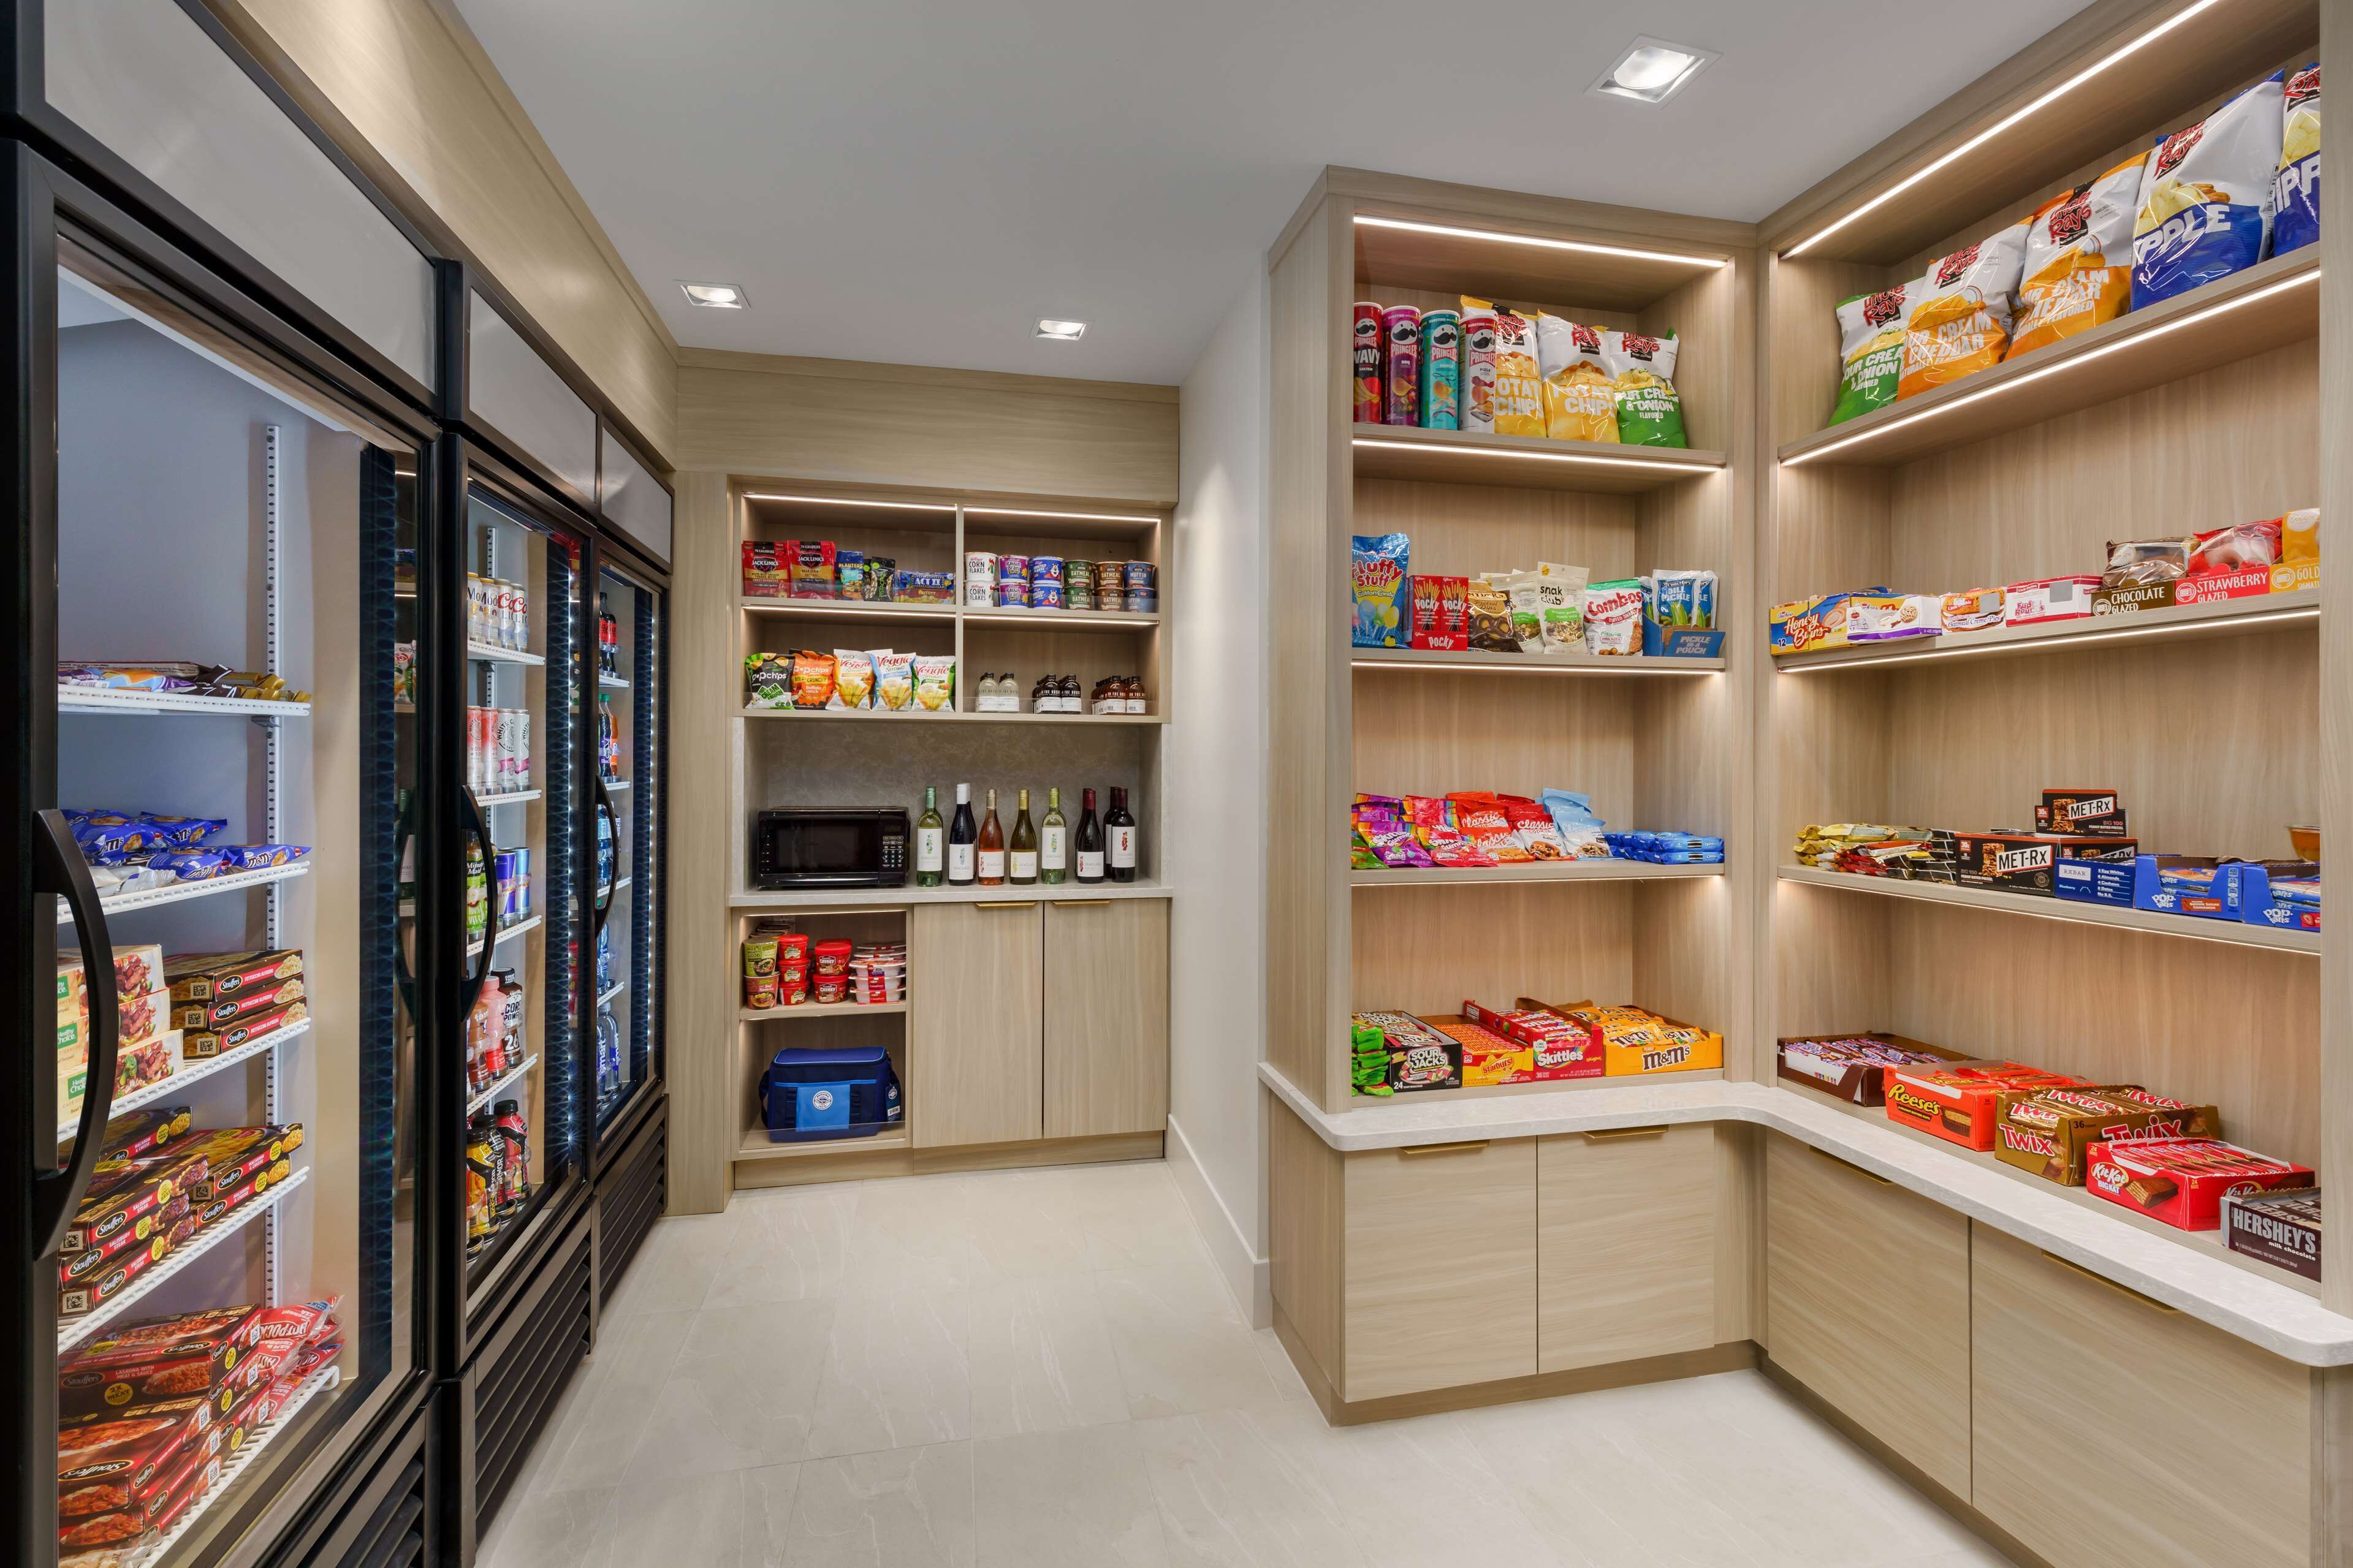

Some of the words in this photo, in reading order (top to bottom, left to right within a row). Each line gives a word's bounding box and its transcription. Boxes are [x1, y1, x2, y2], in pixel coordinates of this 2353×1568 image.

[1355, 338, 1377, 347] PRINGLES
[1391, 344, 1417, 355] PRINGLES
[1431, 347, 1458, 360] PRINGLES
[1470, 352, 1496, 365] PRINGLES
[1636, 400, 1674, 411] ONION
[1356, 574, 1389, 588] Stuff
[2197, 572, 2268, 593] STRAWBERRY
[1540, 585, 1562, 596] snak
[2111, 587, 2165, 605] CHOCOLATE
[2198, 591, 2228, 603] GLAZED
[1415, 598, 1439, 612] Pocky
[1442, 599, 1467, 612] Pocky
[1541, 596, 1562, 605] club
[1587, 592, 1642, 616] Combos
[2112, 603, 2138, 614] GLAZED
[1785, 613, 1820, 633] Honey
[1948, 619, 1969, 628] Oatmeal
[1428, 635, 1453, 650] Pocky
[1793, 628, 1825, 646] Buns
[840, 660, 872, 669] Veggie
[877, 656, 912, 667] Veggie
[916, 665, 949, 676] Veggie
[498, 721, 509, 740] WHITE
[2070, 800, 2110, 818] MET-Rx
[1999, 849, 2047, 870] MET-Rx
[222, 977, 240, 990] Stouffer's
[217, 1004, 236, 1017] Stouffer's
[229, 1031, 247, 1043] Stouffer's
[598, 1037, 607, 1078] smart
[1412, 1048, 1440, 1061] SOUR
[1537, 1050, 1583, 1067] Skittles
[1643, 1045, 1690, 1070] m&m's
[1411, 1055, 1446, 1069] JACKS
[1482, 1058, 1513, 1074] Starburst
[1888, 1083, 1941, 1115] Reese's
[2074, 1120, 2085, 1129] 36
[220, 1170, 240, 1186] Stouffer's
[2097, 1181, 2109, 1191] BIG
[2109, 1183, 2121, 1194] KAT
[133, 1195, 153, 1211] SALISBURY
[137, 1202, 149, 1213] STEAK
[204, 1203, 224, 1219] Stouffer's
[99, 1214, 124, 1237] Stouffer's
[2233, 1207, 2316, 1254] HERSHEY'S
[109, 1230, 131, 1248] SALISBURY
[2268, 1241, 2283, 1250] milk
[2284, 1246, 2316, 1261] chocolate
[72, 1251, 100, 1272] Stouffer's
[131, 1252, 148, 1268] SALISBURY
[102, 1272, 124, 1293] Stouffer's
[108, 1390, 129, 1400] MEAT
